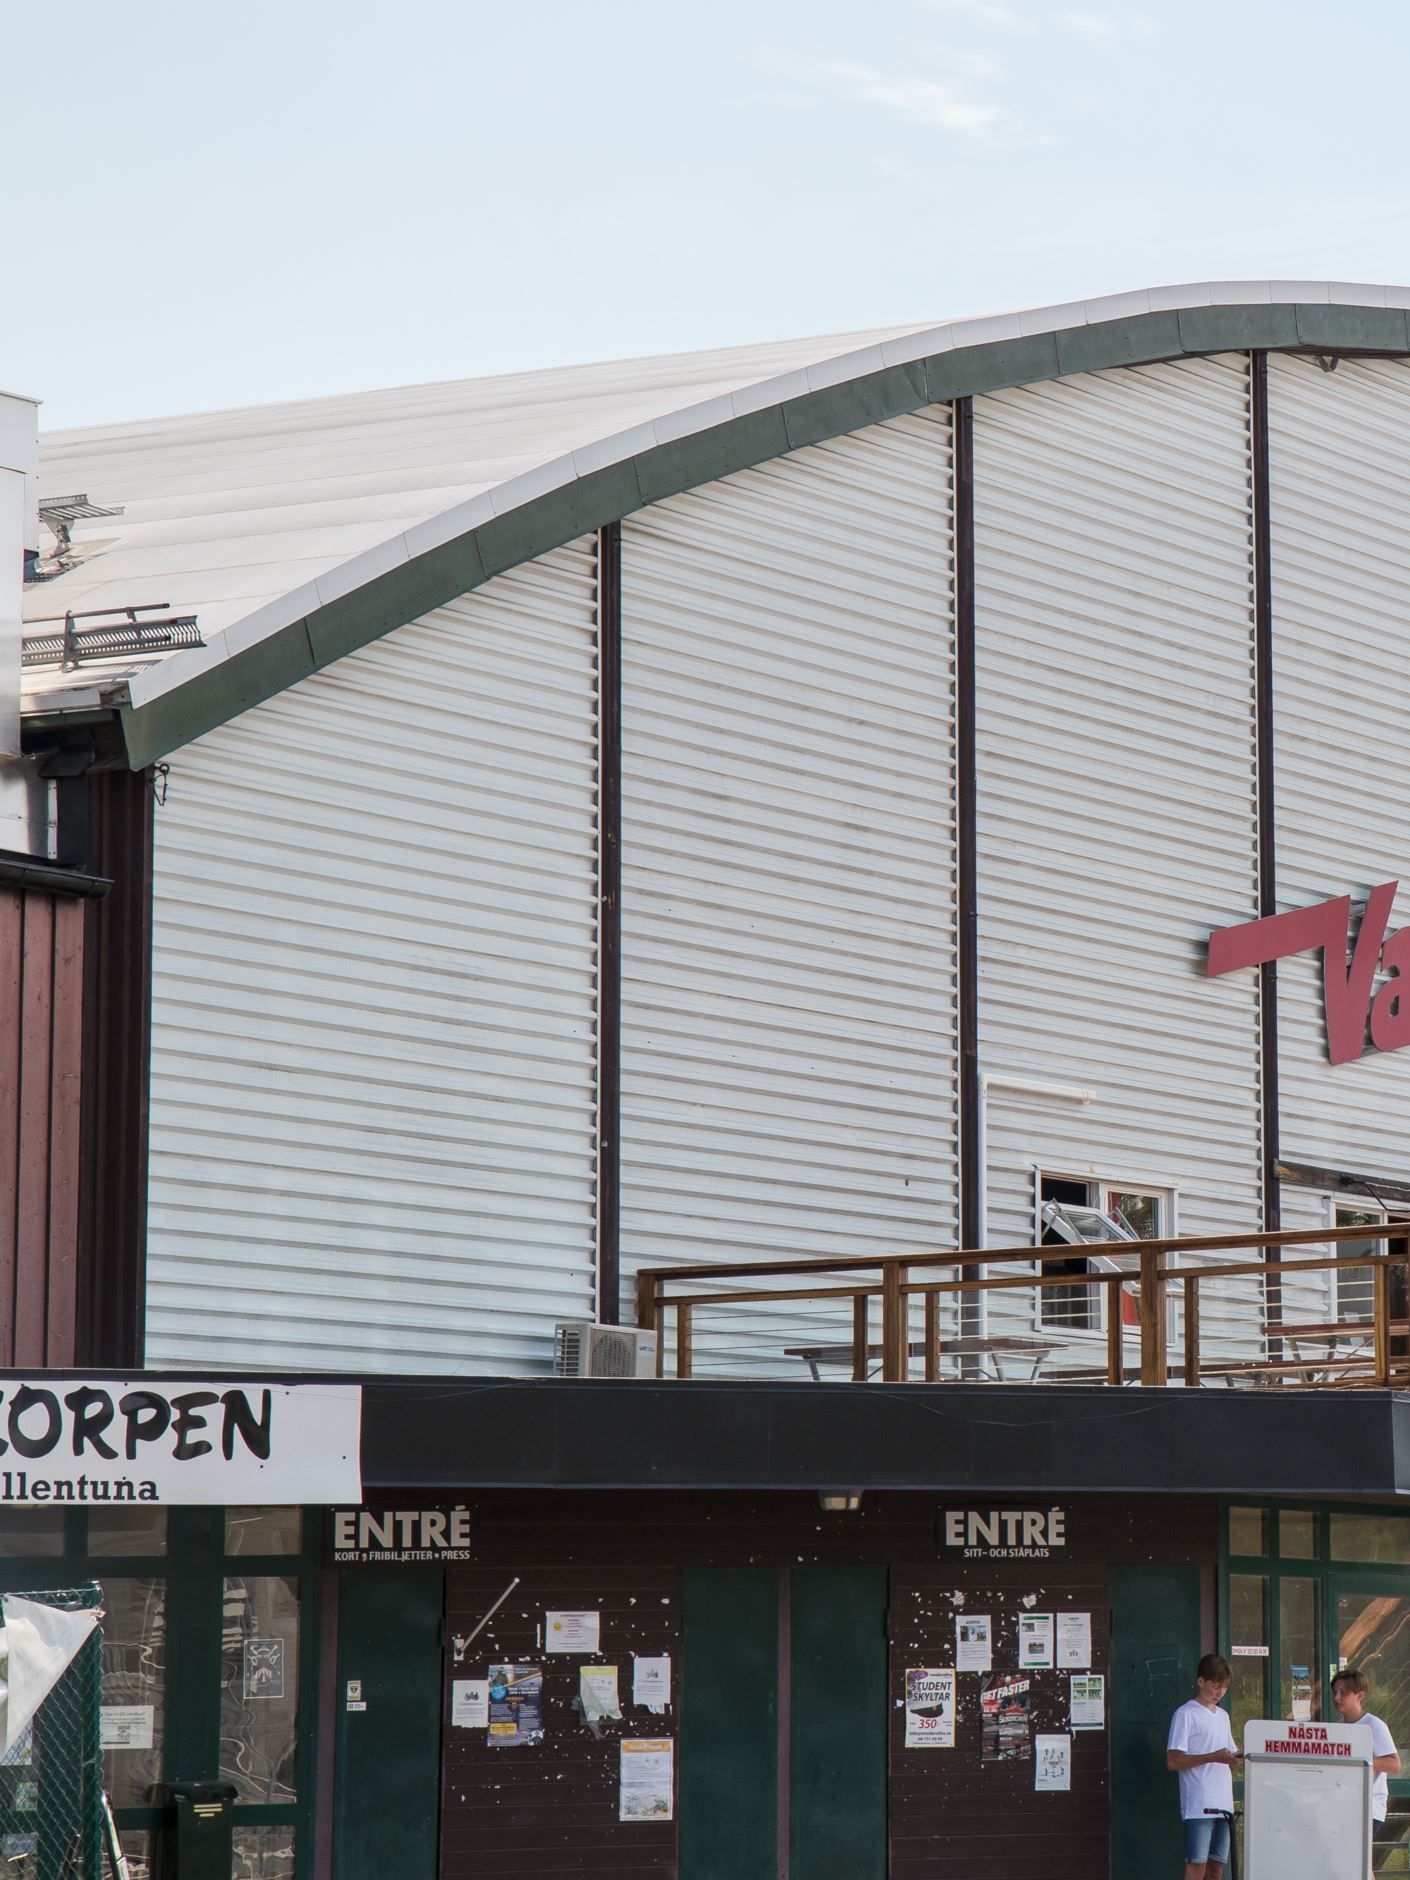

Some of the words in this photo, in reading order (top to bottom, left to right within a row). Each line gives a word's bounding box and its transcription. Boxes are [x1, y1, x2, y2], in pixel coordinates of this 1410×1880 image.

[334, 1505, 471, 1549] ENTRÉ
[945, 1506, 1066, 1546] ENTRÉ
[334, 1551, 360, 1561] KORT
[369, 1550, 433, 1562] FRIBILJETTER
[441, 1550, 471, 1560] PRESS
[963, 1548, 988, 1558] SITT-
[989, 1548, 1007, 1558] OCH
[1008, 1546, 1050, 1558] STÅPLATS
[912, 1681, 952, 1691] STUDENT
[996, 1679, 1031, 1702] FASTER
[913, 1692, 951, 1702] SKYLTAR
[1288, 1723, 1328, 1740] NÄSTA
[1265, 1740, 1352, 1756] HEMMAMATCH
